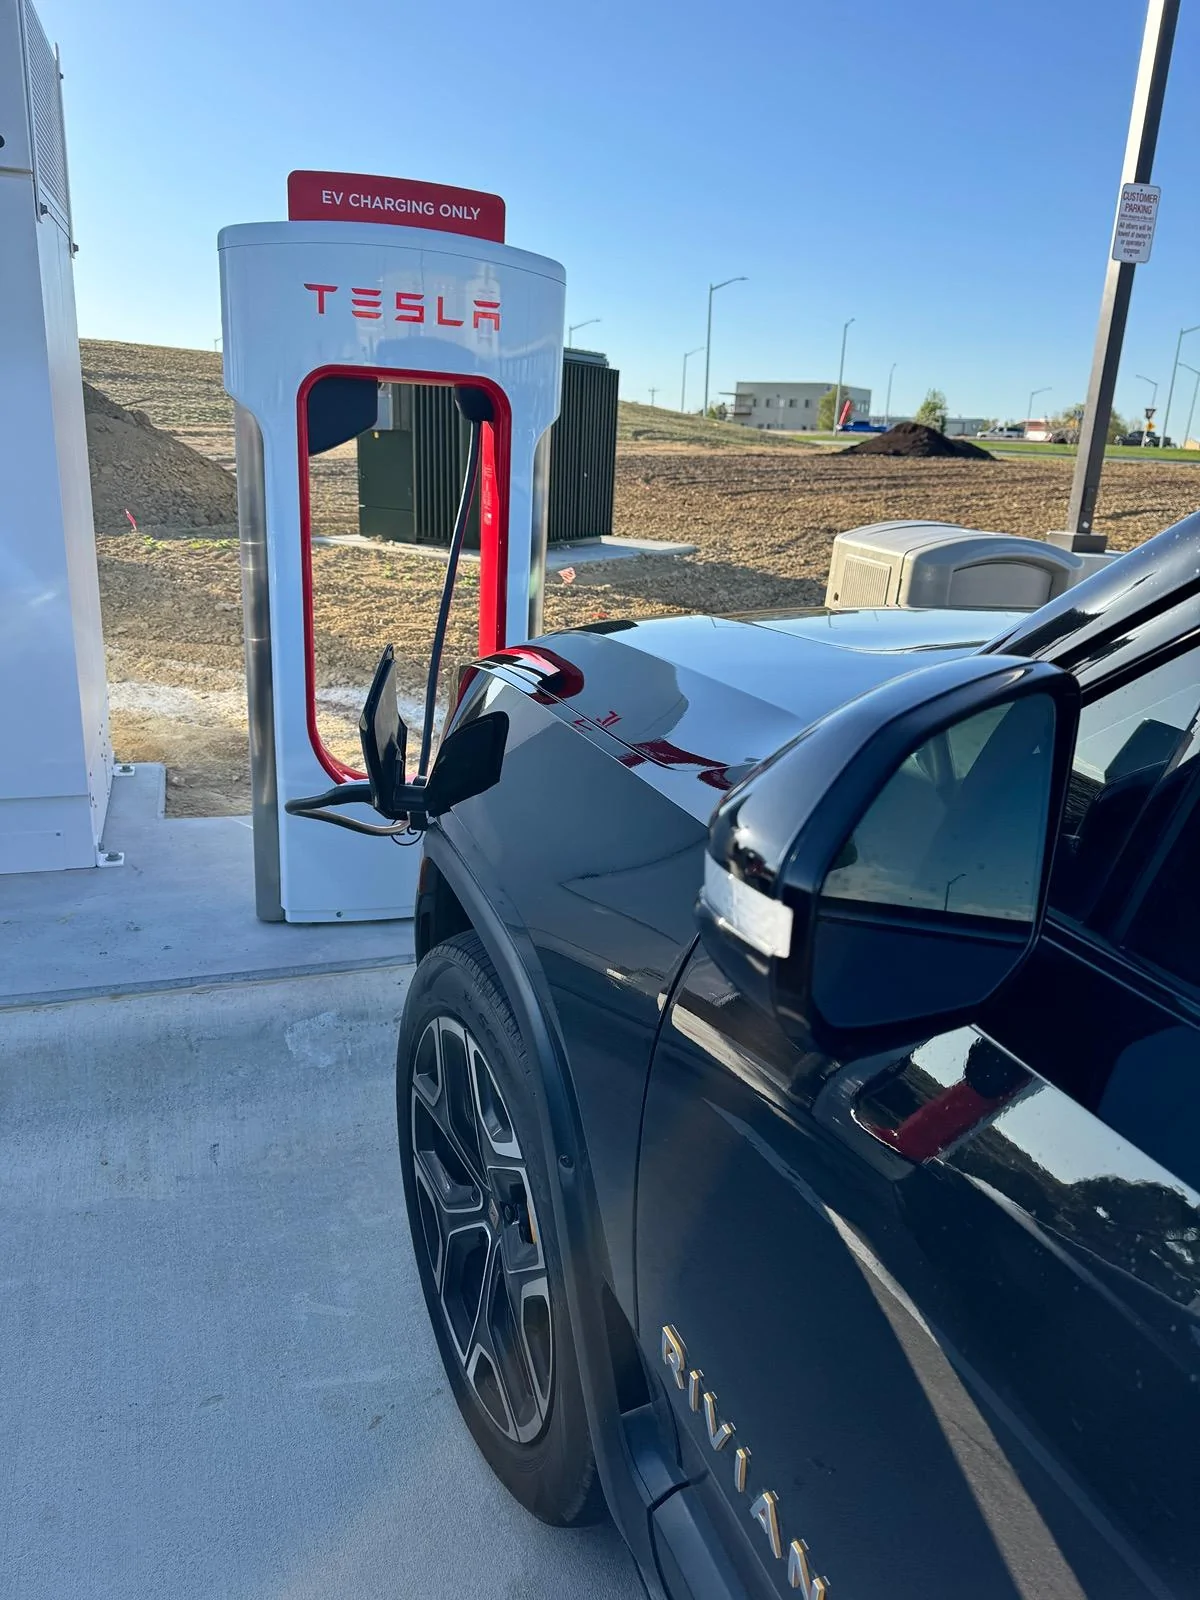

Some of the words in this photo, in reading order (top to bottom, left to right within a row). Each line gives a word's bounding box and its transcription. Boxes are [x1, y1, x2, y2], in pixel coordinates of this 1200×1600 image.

[321, 190, 344, 205] EV
[348, 193, 435, 216] CHARGING
[439, 204, 481, 221] ONLY
[1122, 191, 1158, 204] CUSTOMER
[1124, 203, 1153, 215] PARKING
[1126, 223, 1138, 231] others
[303, 283, 501, 331] TESLA
[661, 1324, 828, 1600] RIVIAN
